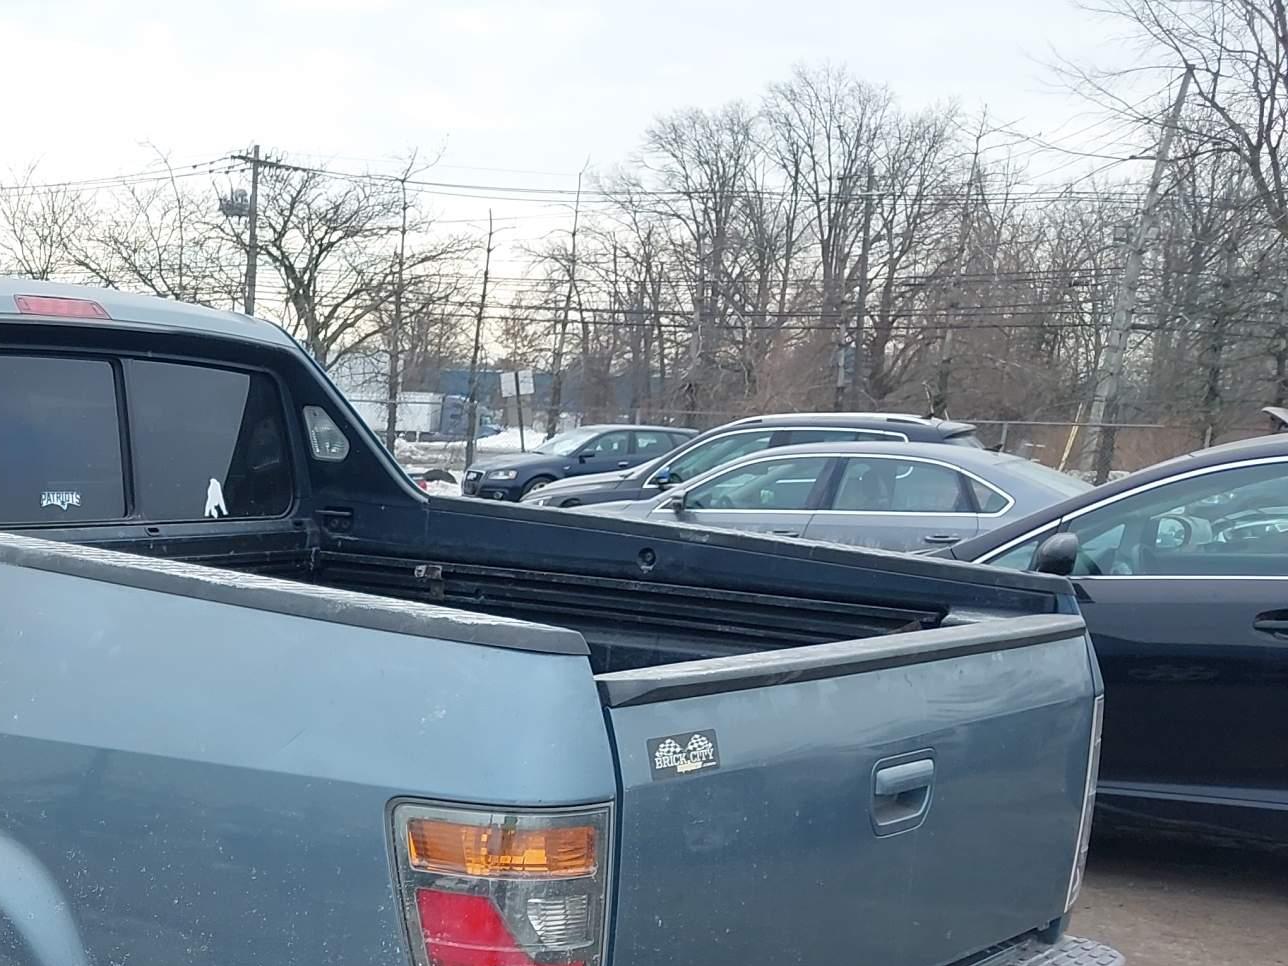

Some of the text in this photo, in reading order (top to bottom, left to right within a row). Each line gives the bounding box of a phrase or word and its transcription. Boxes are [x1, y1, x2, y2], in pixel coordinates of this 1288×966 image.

[40, 491, 81, 508] PATRIOTS
[654, 753, 688, 769] BRICK
[690, 748, 714, 762] CITY
